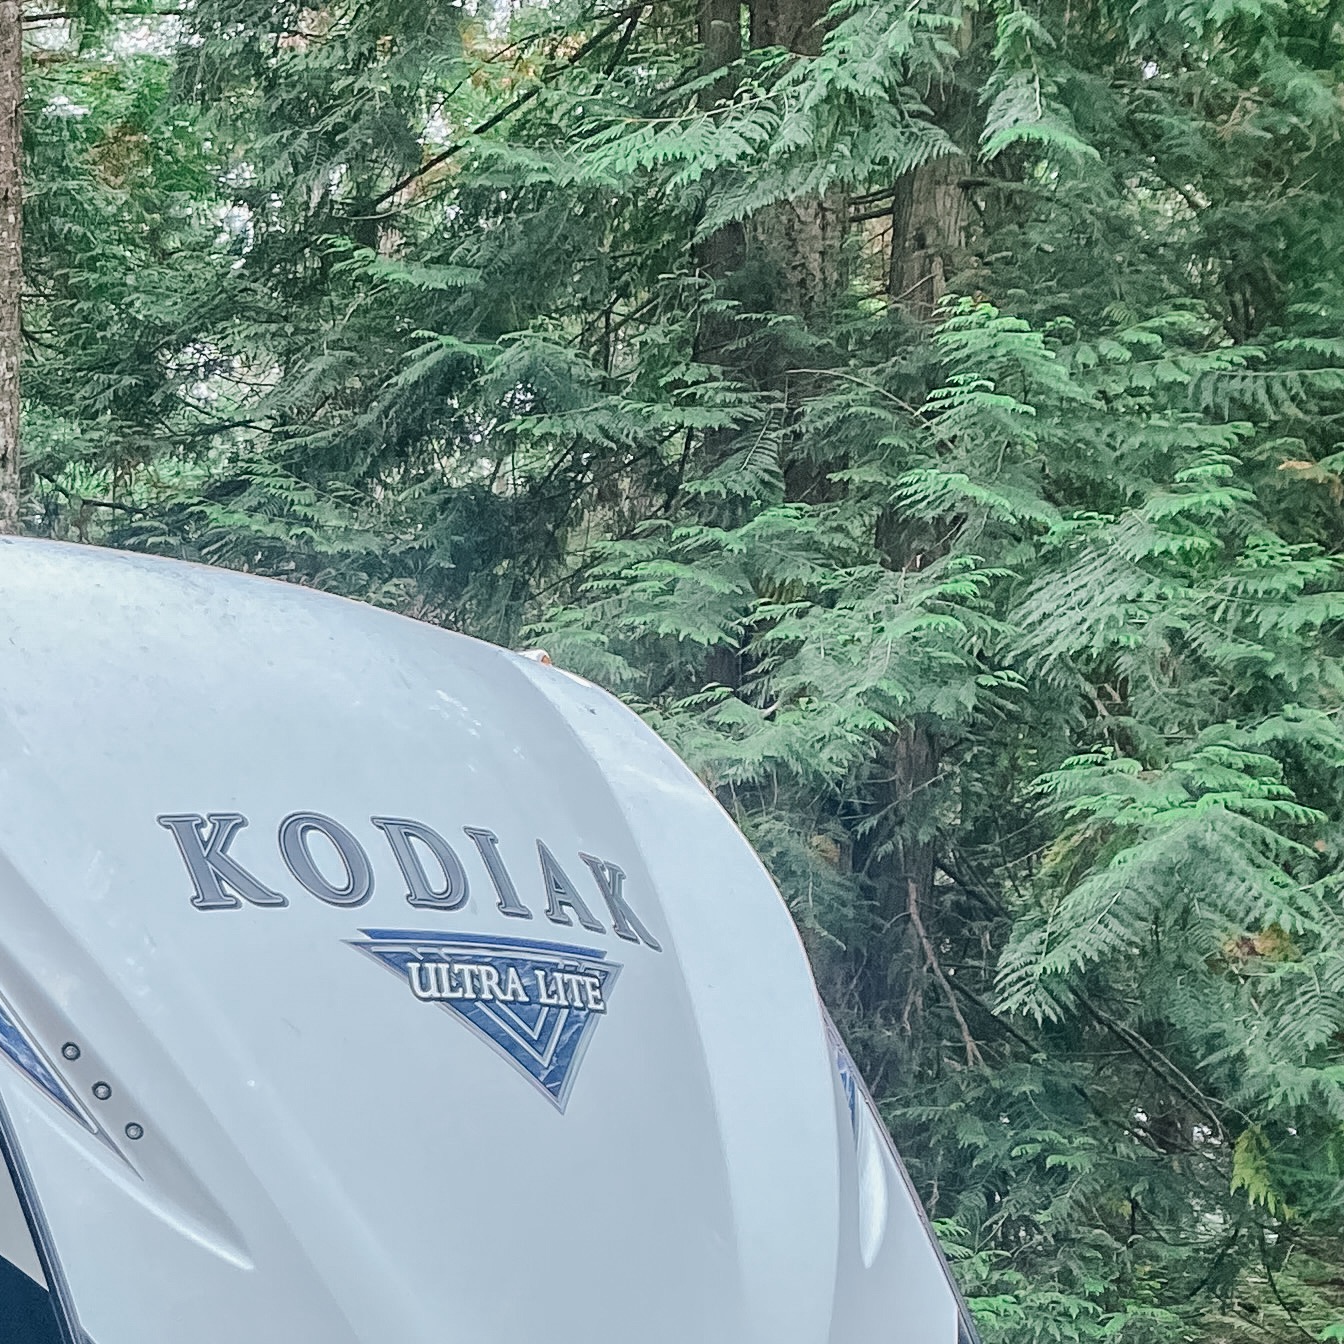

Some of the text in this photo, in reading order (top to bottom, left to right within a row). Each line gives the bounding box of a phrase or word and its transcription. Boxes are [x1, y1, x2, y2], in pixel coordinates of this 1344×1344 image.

[156, 811, 662, 953] KODIAK
[406, 961, 606, 1012] ULTRA LITE
